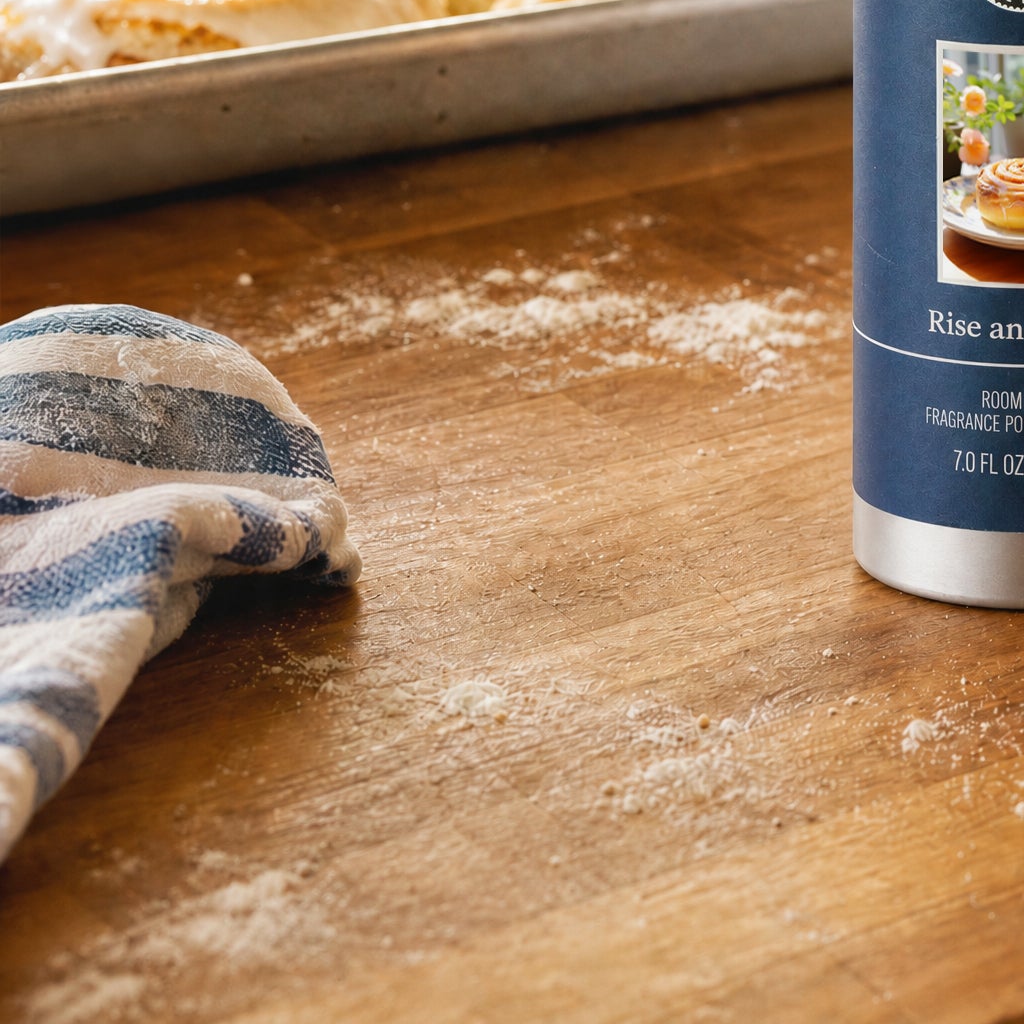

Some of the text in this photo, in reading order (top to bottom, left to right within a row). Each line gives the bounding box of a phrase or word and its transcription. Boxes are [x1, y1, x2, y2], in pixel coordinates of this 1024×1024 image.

[928, 309, 981, 337] Rise
[981, 391, 1022, 410] ROOM
[925, 406, 1001, 433] FRAGRANCE
[953, 449, 976, 473] 7.0
[980, 453, 999, 475] FL
[1003, 454, 1024, 476] OZ
